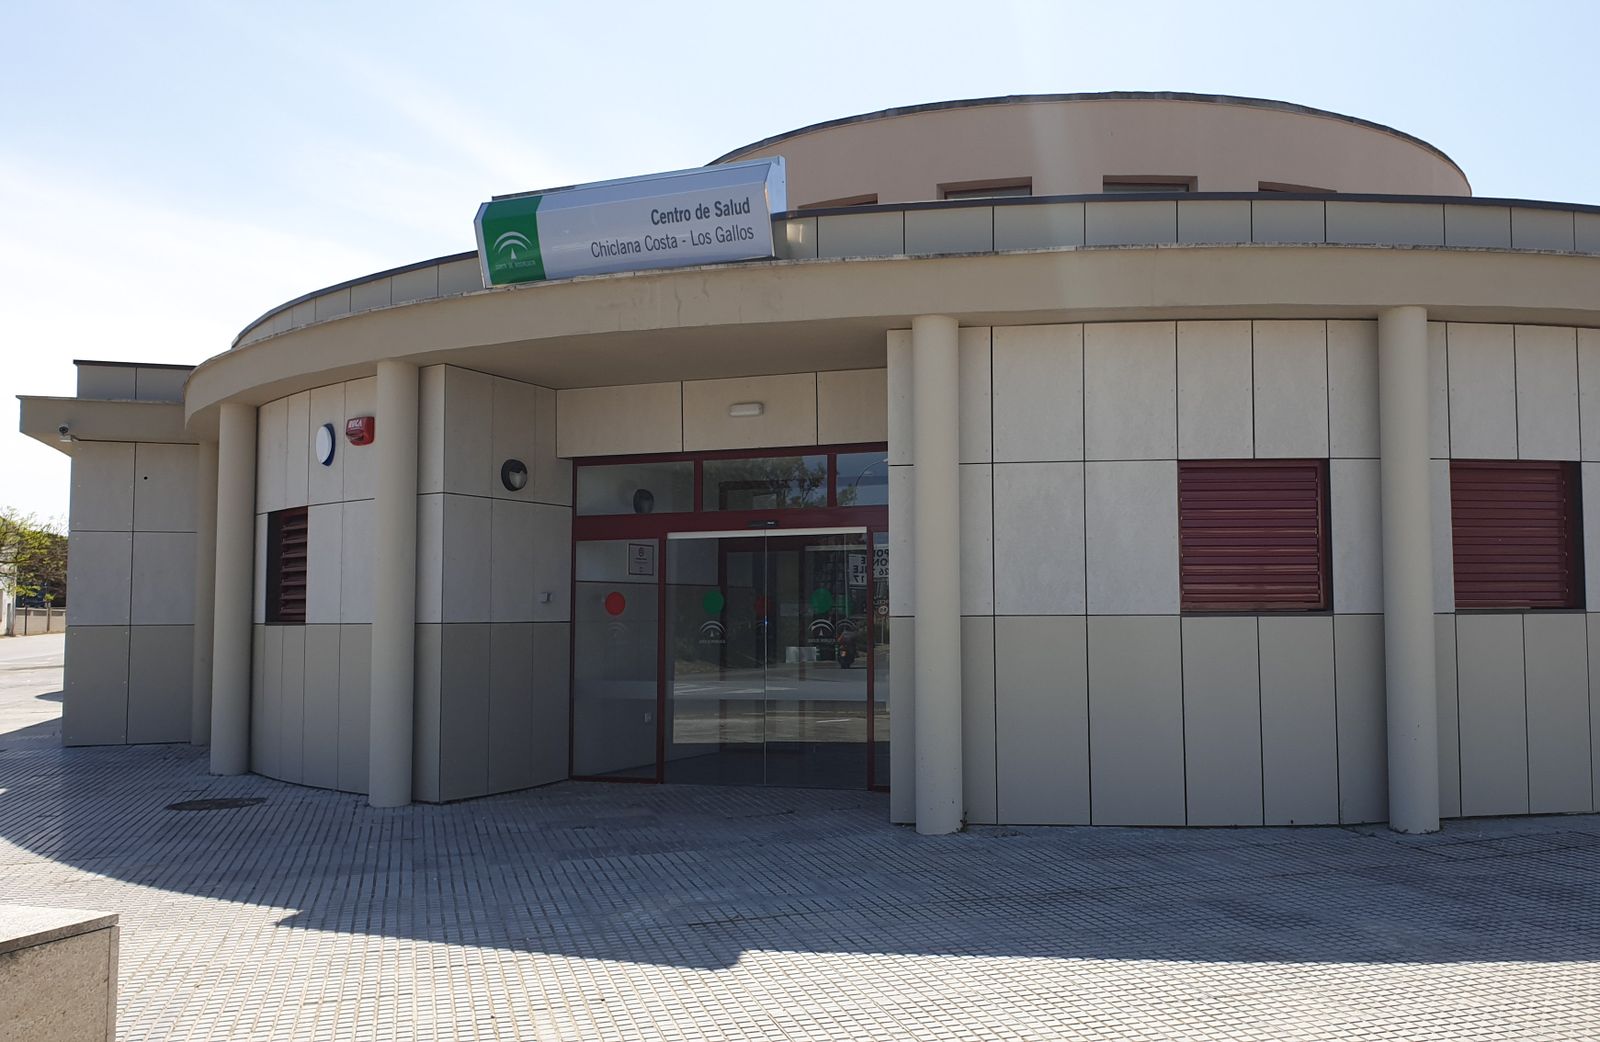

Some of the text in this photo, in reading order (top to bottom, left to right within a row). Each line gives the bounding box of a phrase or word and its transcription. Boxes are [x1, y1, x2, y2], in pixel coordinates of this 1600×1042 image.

[651, 197, 751, 225] Centro de Salud
[591, 238, 642, 258] Chiclana
[644, 234, 678, 252] Costa
[690, 230, 712, 247] Los
[715, 224, 754, 244] Gallos
